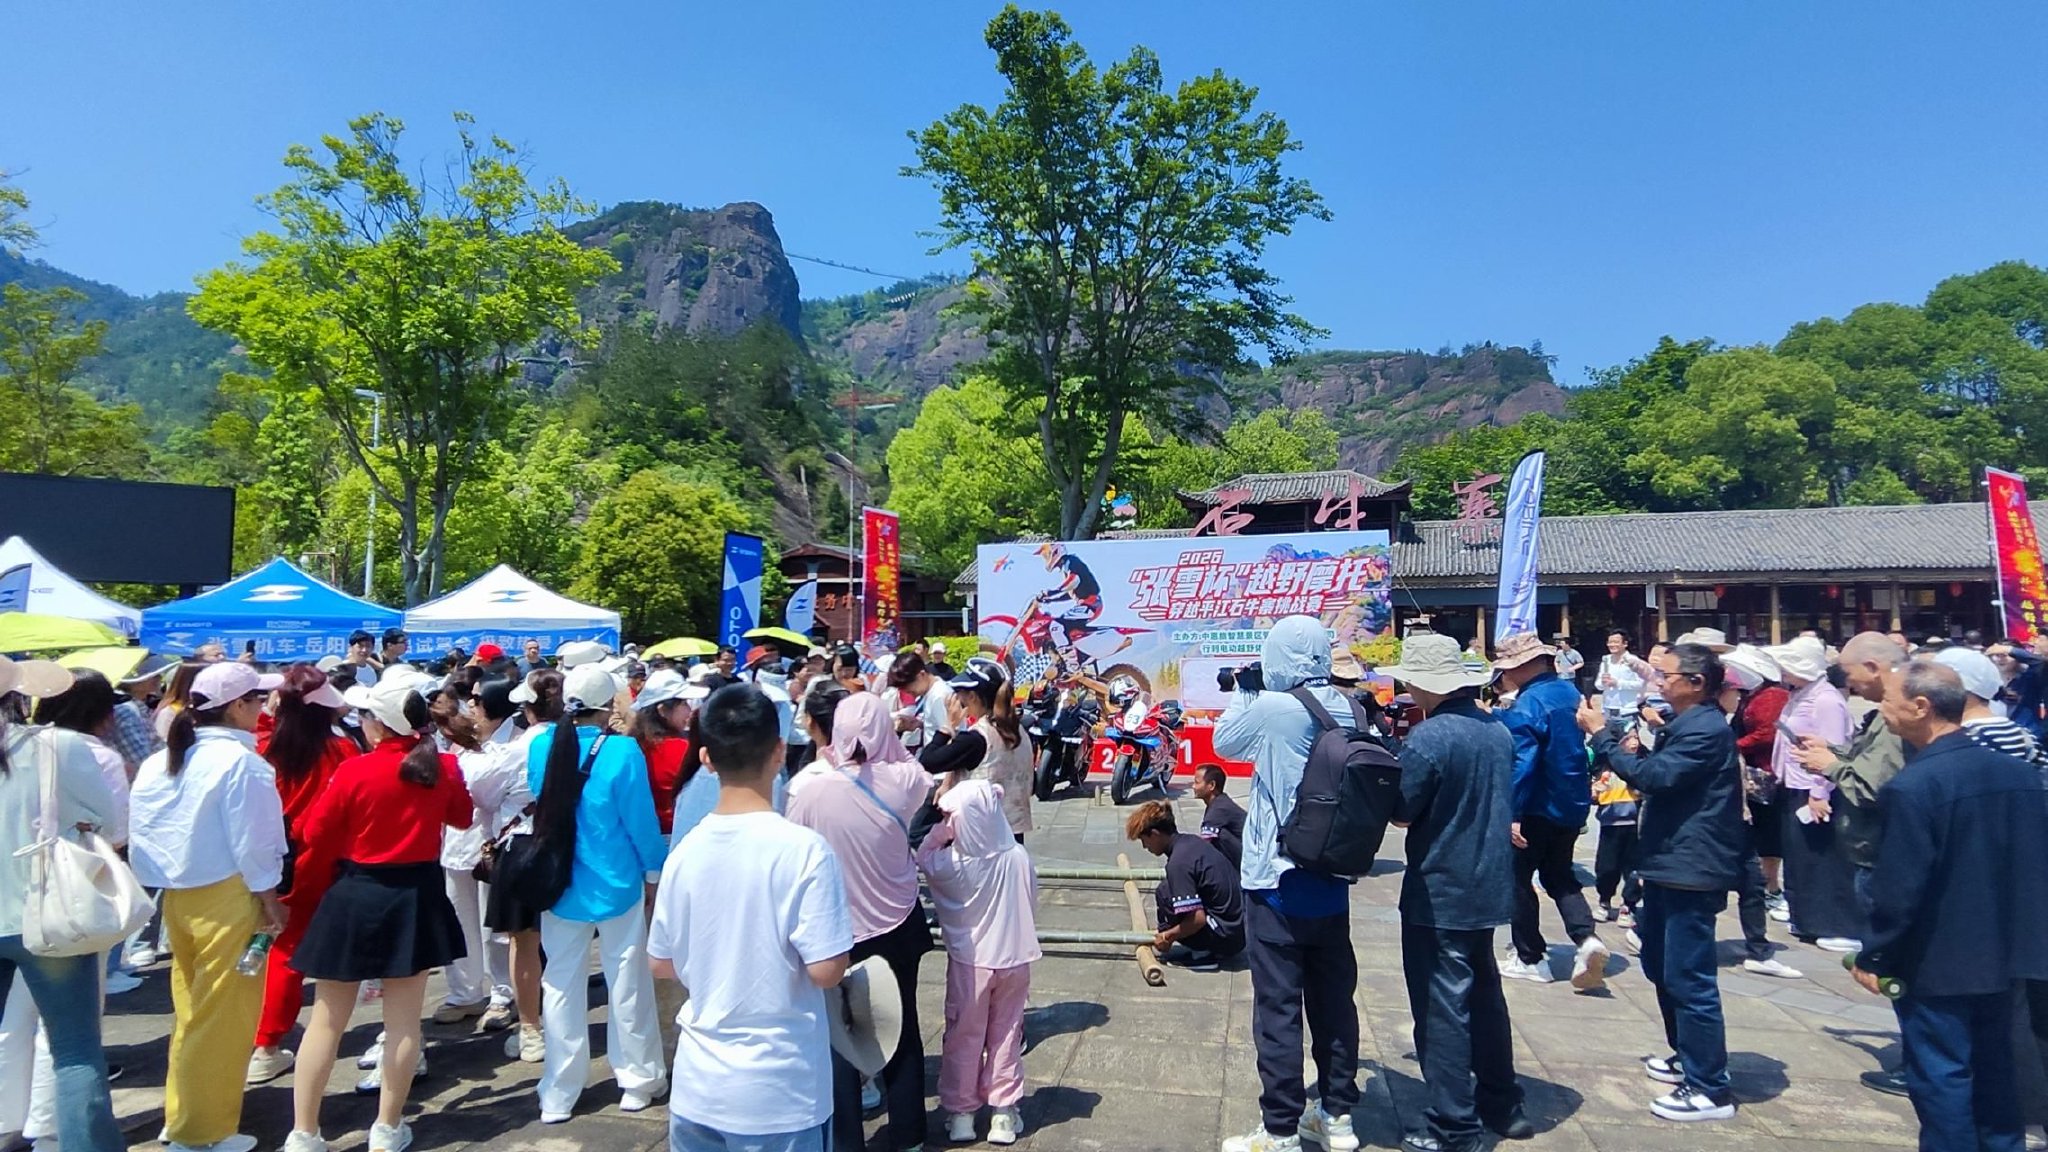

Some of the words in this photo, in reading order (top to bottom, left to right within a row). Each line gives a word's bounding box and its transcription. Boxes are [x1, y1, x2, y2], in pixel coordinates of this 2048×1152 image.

[1178, 550, 1223, 566] 2026
[1168, 595, 1323, 619] 穿越平江石牛寨挑战赛
[1102, 748, 1114, 769] 2
[1179, 739, 1196, 764] 1
